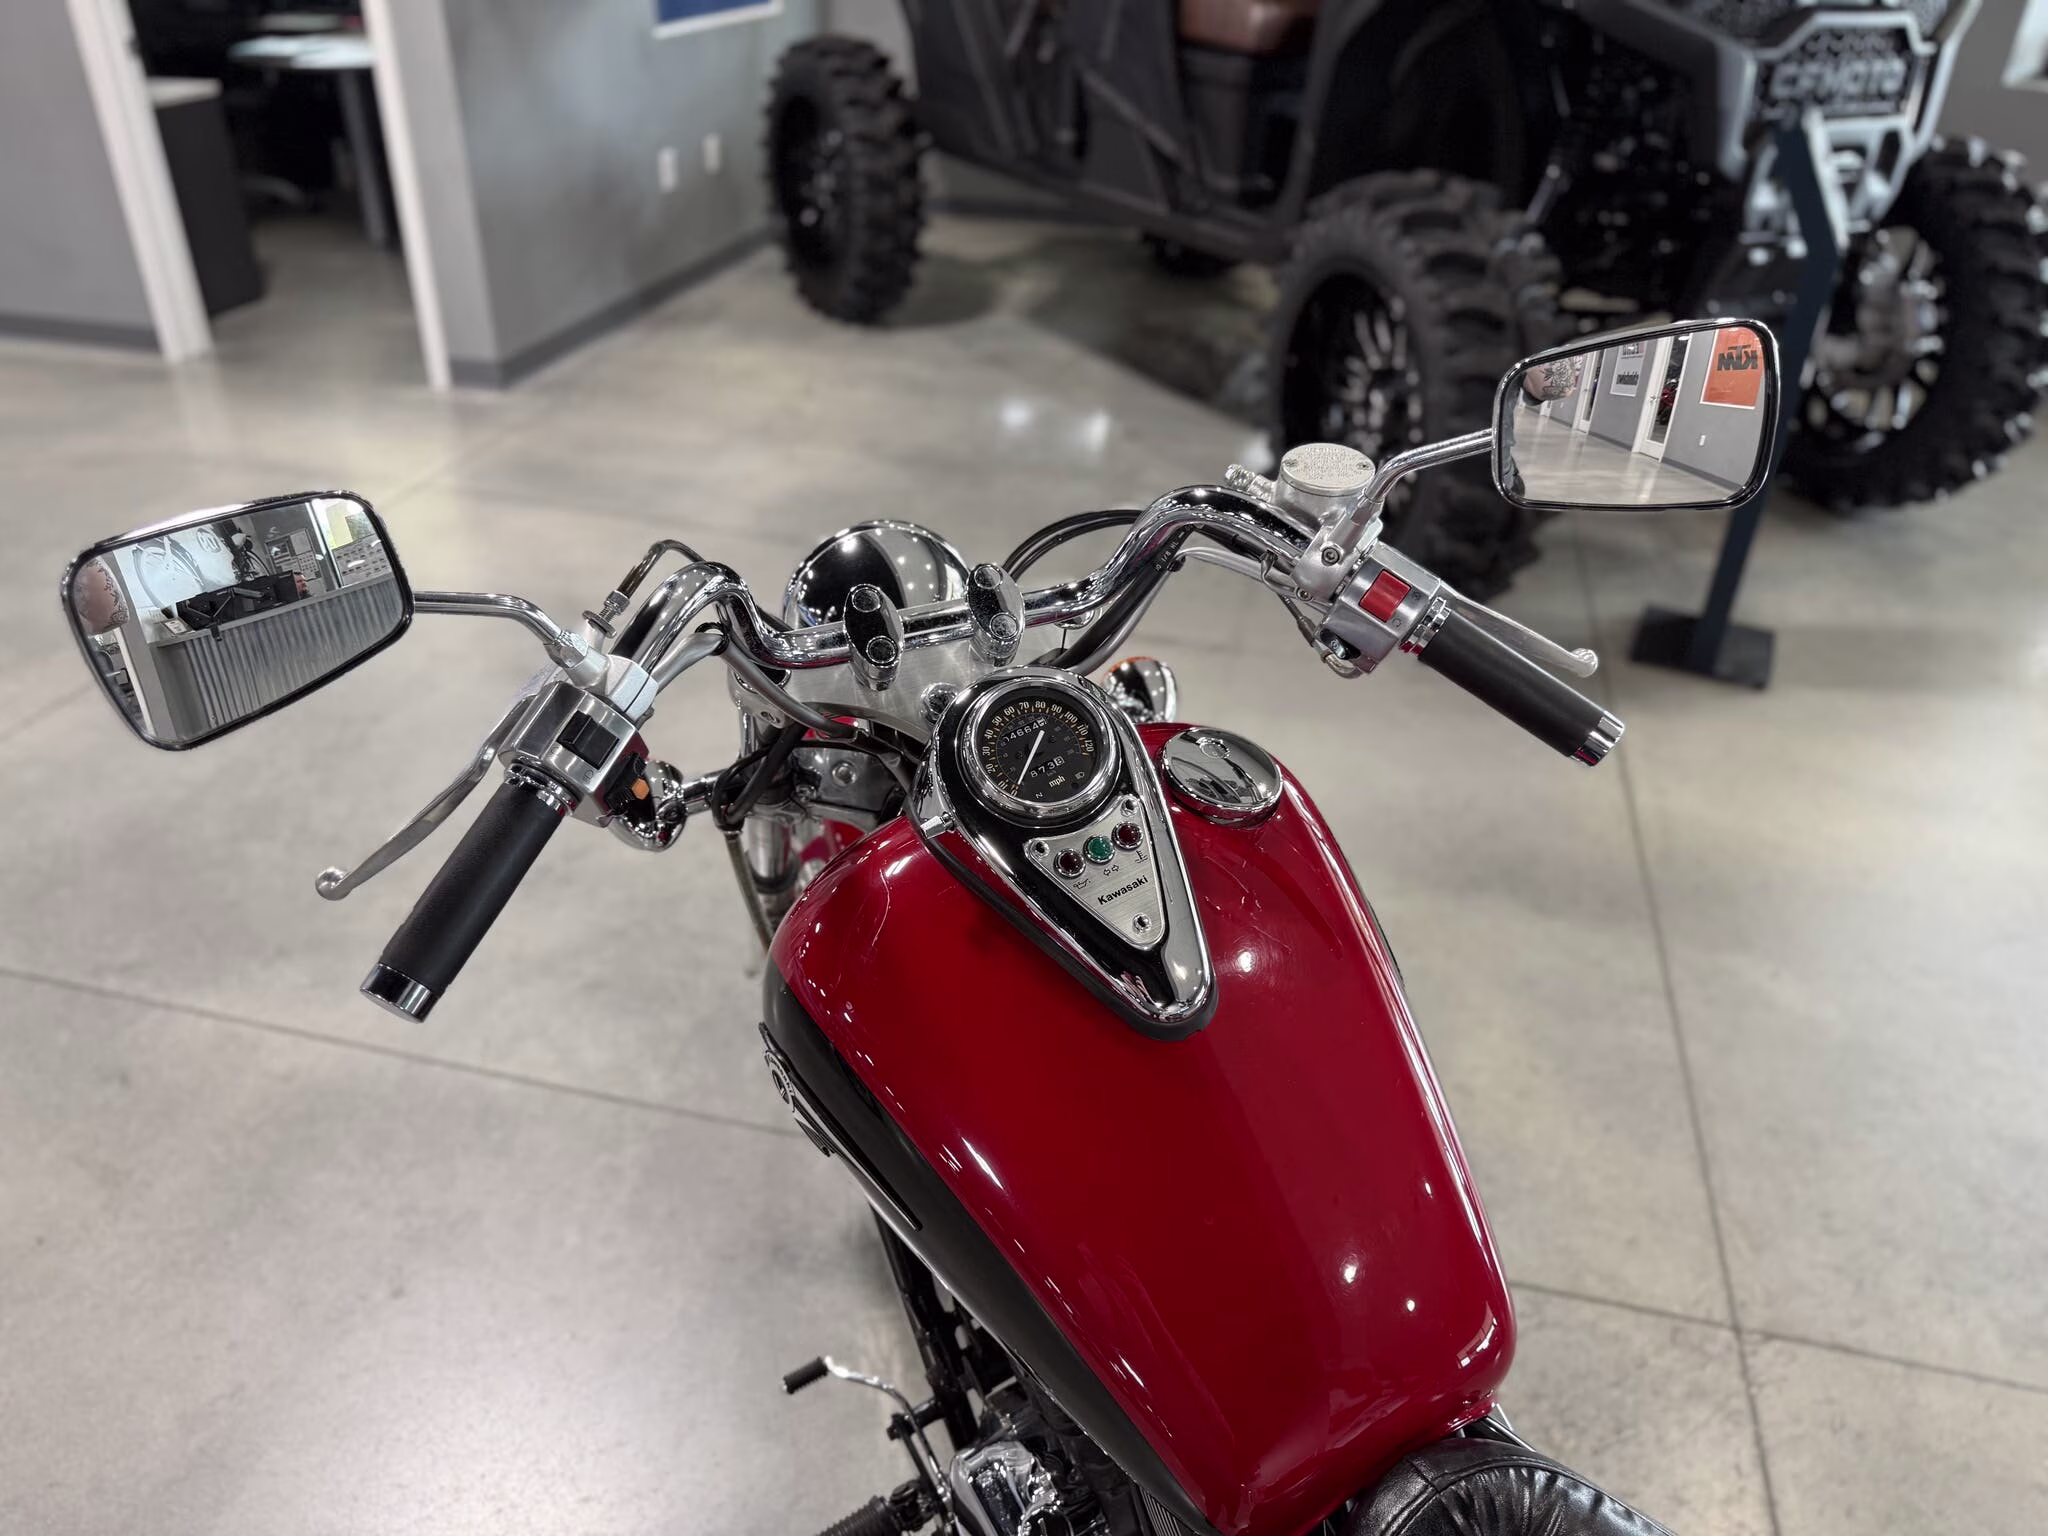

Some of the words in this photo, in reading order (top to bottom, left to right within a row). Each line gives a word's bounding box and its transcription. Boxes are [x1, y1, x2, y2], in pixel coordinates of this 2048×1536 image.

[1018, 701, 1030, 710] 70
[1035, 700, 1046, 709] 80
[1051, 704, 1063, 714] 90
[1003, 706, 1015, 716] 60
[991, 716, 1003, 727] 50
[1064, 711, 1078, 724] 100
[984, 729, 994, 739] 40
[1077, 723, 1089, 737] 110
[982, 746, 991, 756] 30
[1084, 739, 1095, 753] 120
[985, 763, 996, 774] 20
[1048, 775, 1066, 788] mph
[1097, 874, 1149, 906] Kawasaki
